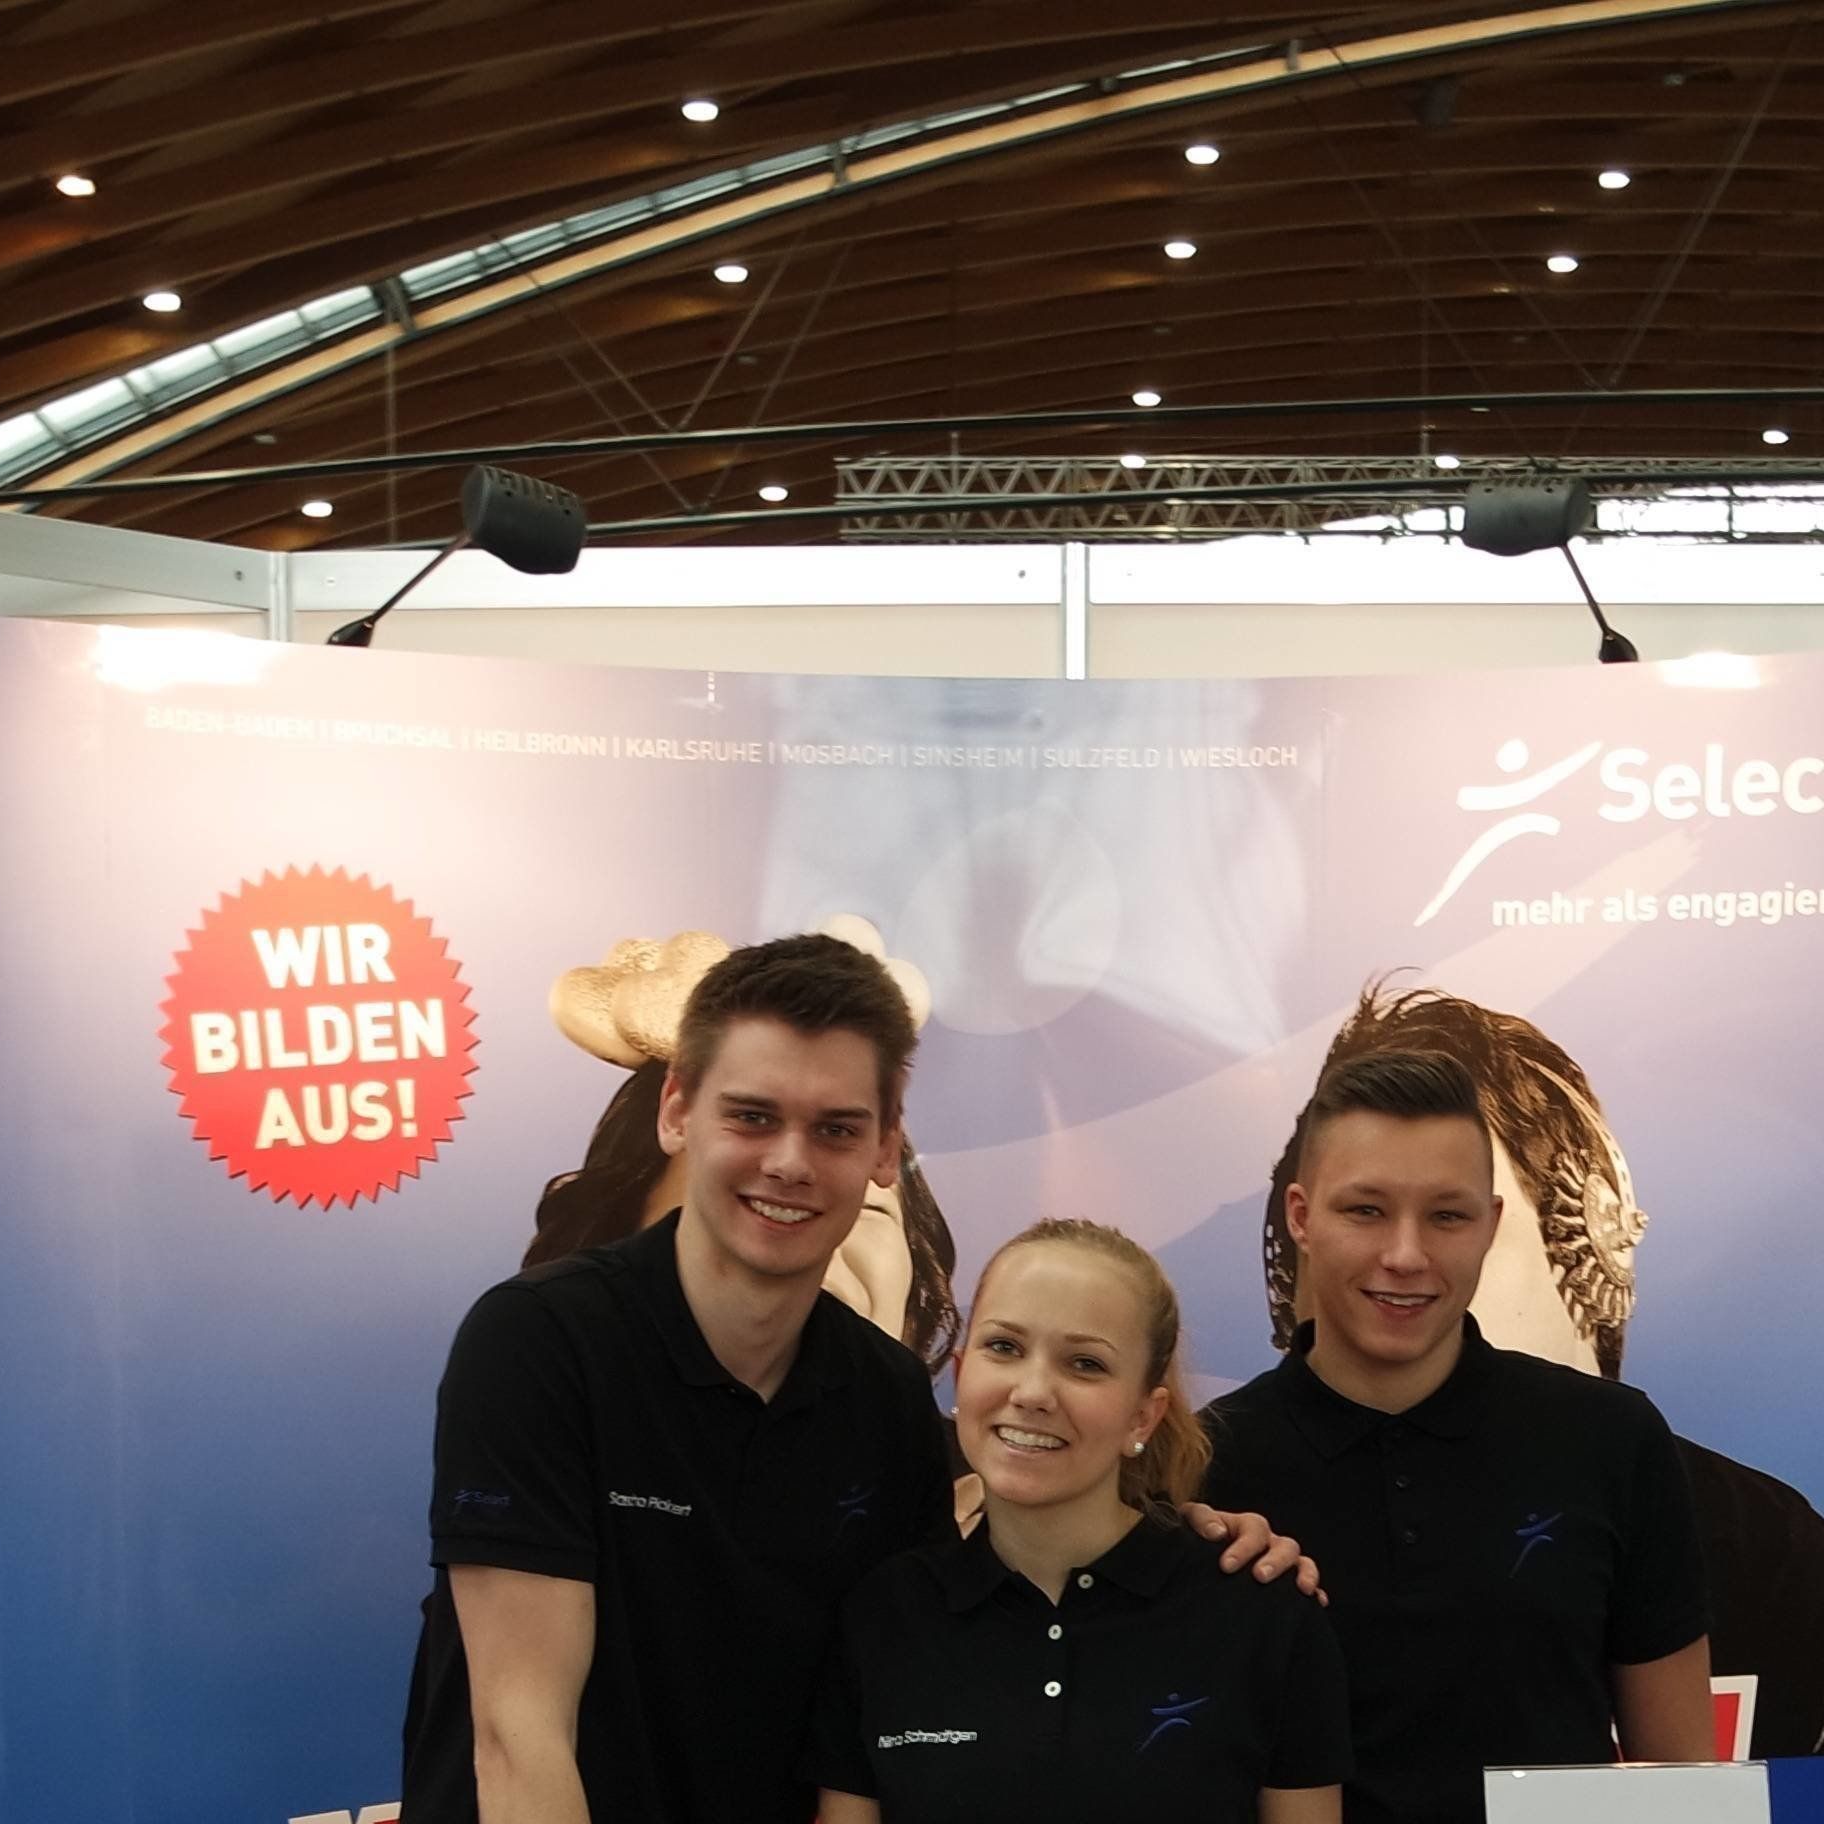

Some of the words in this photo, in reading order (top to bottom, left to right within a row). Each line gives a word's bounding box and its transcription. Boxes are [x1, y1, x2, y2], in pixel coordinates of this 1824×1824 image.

[477, 730, 608, 758] HEILBRONN
[626, 738, 762, 763] KARLSRUHE
[782, 744, 893, 767] MOSBACH
[914, 746, 1024, 768] SINSHEIM
[1044, 747, 1160, 769] SULZFELD
[1181, 745, 1298, 769] WIESLOCH
[1491, 890, 1594, 926] mehr
[1602, 886, 1658, 923] als
[250, 923, 395, 989] WIR
[190, 998, 448, 1075] BILDEN
[255, 1078, 419, 1150] AUS!
